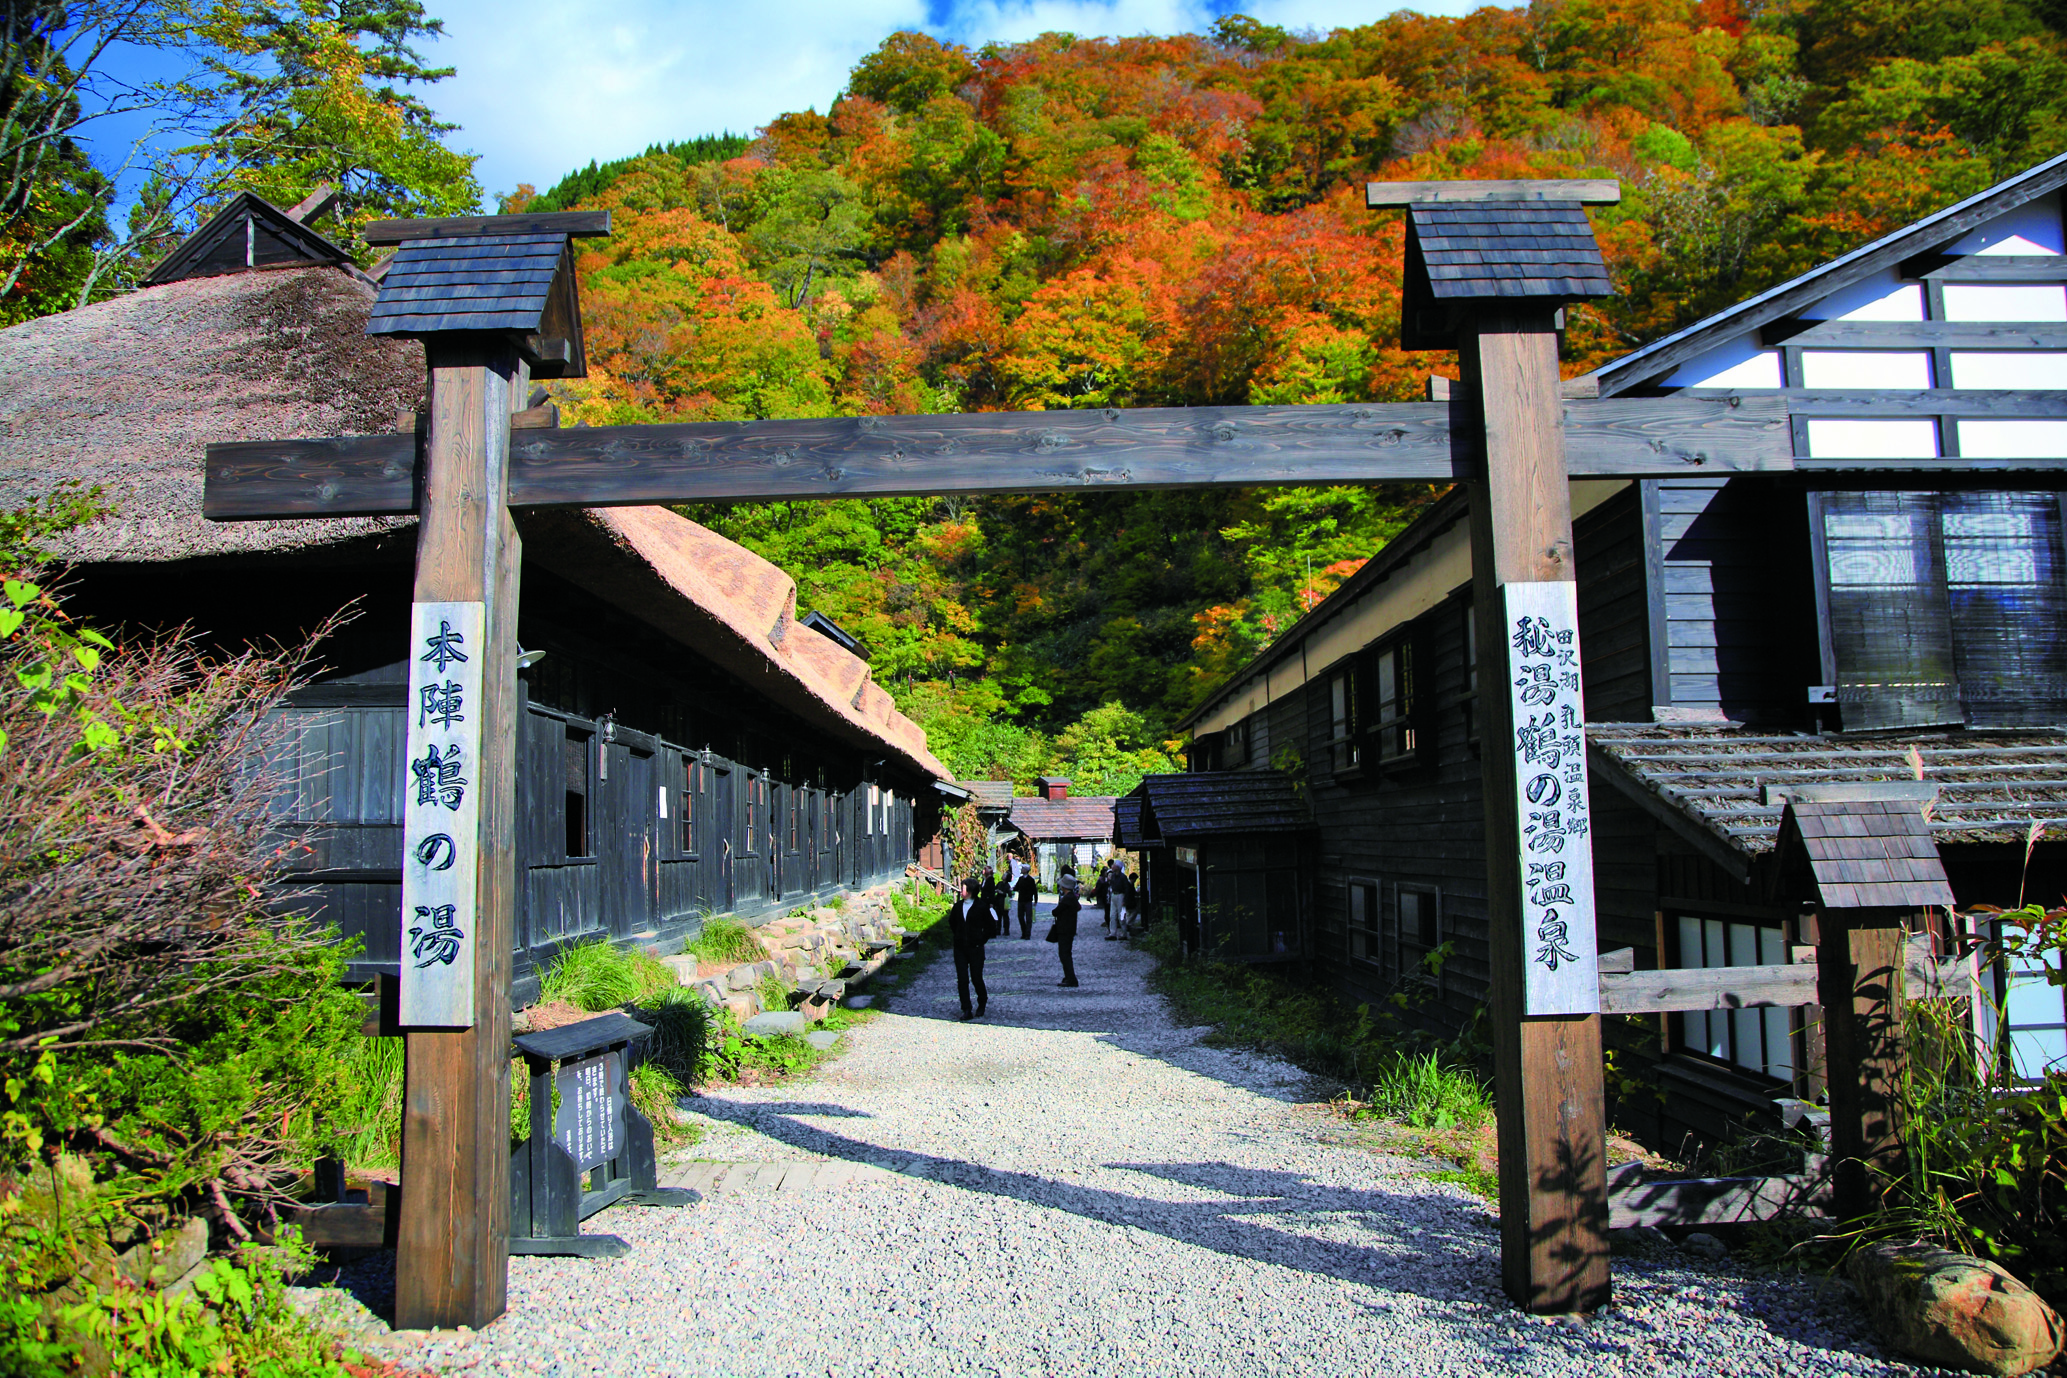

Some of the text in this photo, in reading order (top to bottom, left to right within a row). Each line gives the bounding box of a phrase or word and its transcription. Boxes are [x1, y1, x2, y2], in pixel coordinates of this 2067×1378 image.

[408, 620, 469, 970] 本陣鶴の湯
[1512, 615, 1580, 972] 秘湯鶴の湯温泉
[1555, 629, 1588, 839] 田沢湖 乳頭温泉郷
